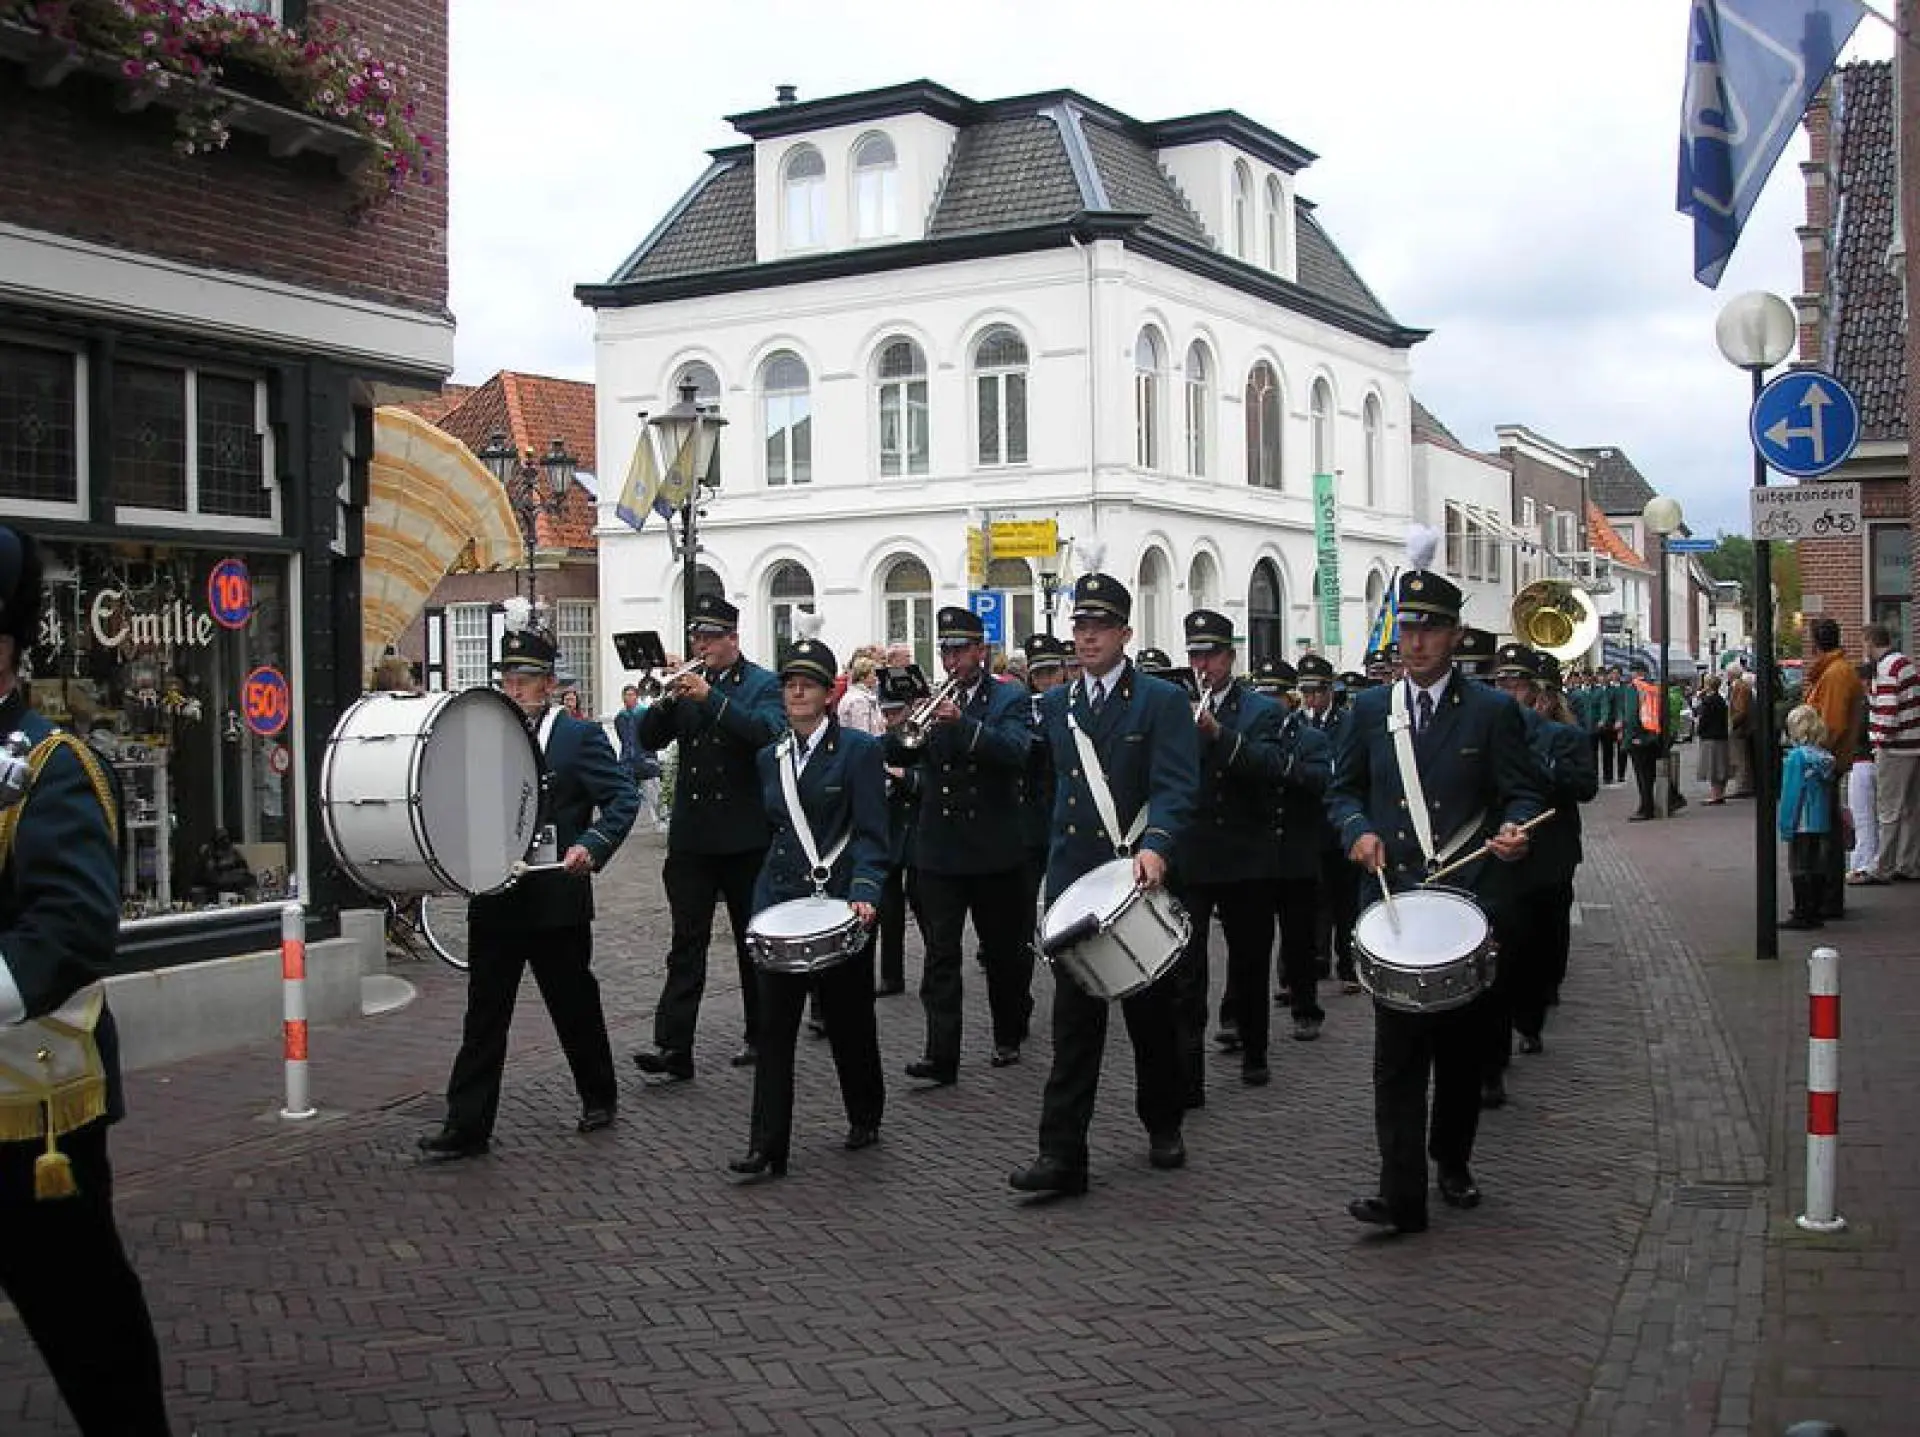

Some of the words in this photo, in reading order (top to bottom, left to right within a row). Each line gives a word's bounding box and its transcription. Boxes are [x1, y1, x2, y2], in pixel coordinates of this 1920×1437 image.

[1756, 487, 1854, 504] uitgezonderd
[976, 596, 996, 617] P
[91, 589, 216, 647] Emilie
